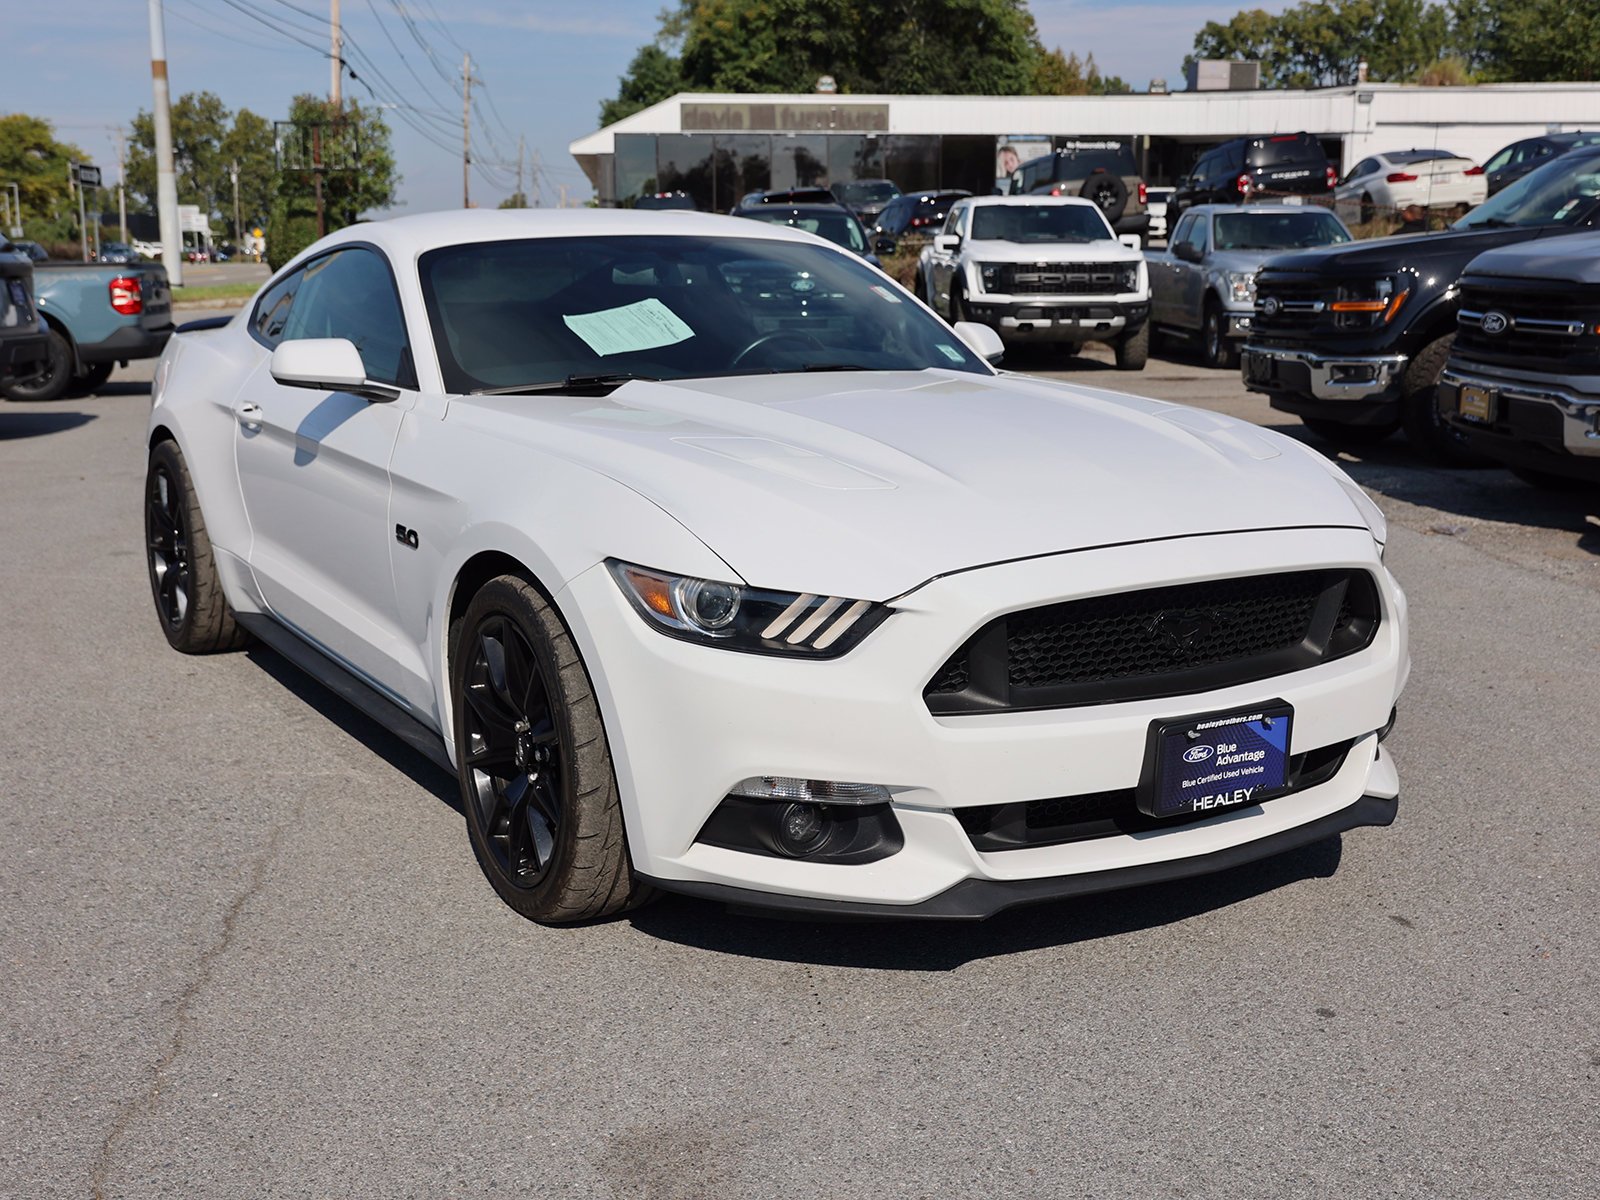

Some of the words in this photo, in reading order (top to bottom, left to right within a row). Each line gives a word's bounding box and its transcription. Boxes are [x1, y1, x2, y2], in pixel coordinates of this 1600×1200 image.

[396, 523, 419, 550] 5.0
[1196, 713, 1263, 730] healeybrothers.com
[1188, 746, 1209, 761] Ford
[1216, 743, 1237, 755] Blue
[1215, 750, 1265, 767] Advantage
[1182, 779, 1196, 788] Blue
[1197, 772, 1223, 785] Certified
[1223, 769, 1240, 779] Used
[1240, 765, 1264, 776] Vehicle
[1193, 787, 1254, 811] HEALEY
